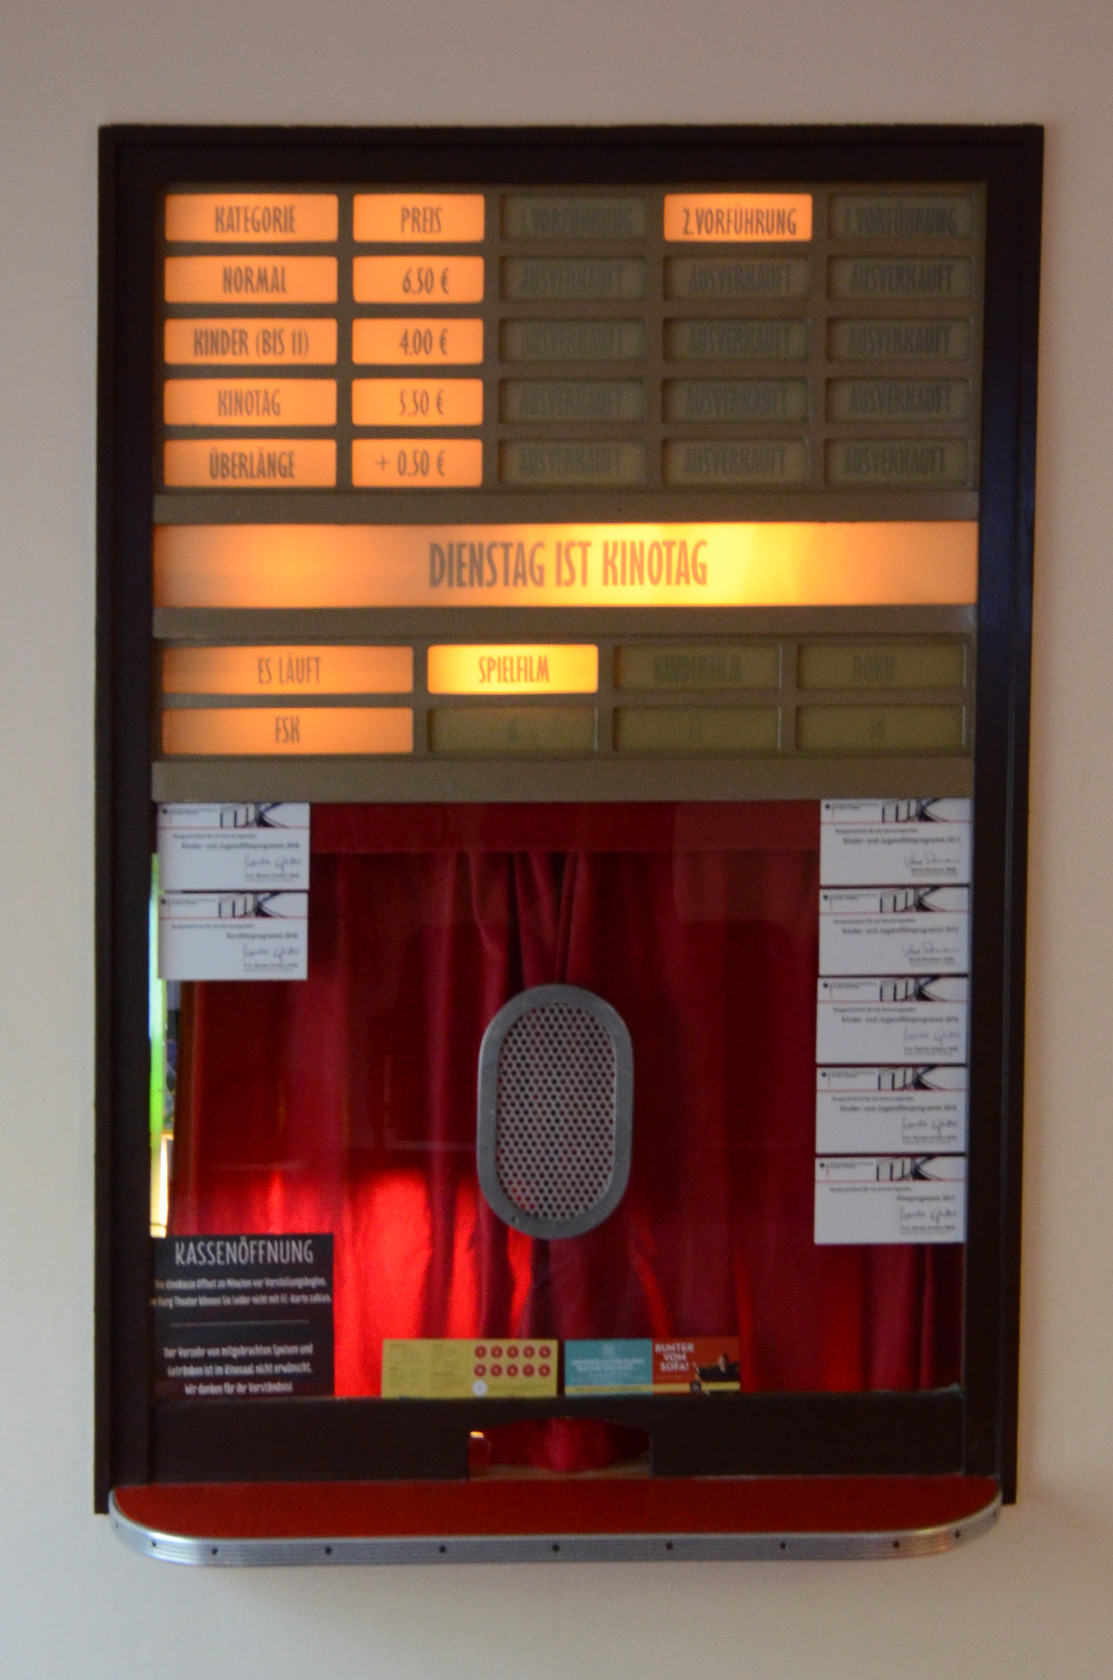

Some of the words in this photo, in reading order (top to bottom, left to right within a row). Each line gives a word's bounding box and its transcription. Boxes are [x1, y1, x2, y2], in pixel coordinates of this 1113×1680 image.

[214, 205, 296, 234] KATEGORIE
[400, 206, 443, 234] PREIS
[222, 266, 287, 294] NORMAL
[402, 266, 434, 295] 6.50
[440, 266, 450, 294] €
[193, 328, 249, 356] KINDER
[255, 328, 286, 358] (BIS
[399, 328, 433, 356] 4.00
[438, 328, 448, 356] €
[217, 389, 281, 416] KINOTAG
[399, 389, 430, 416] 5.50
[435, 389, 444, 416] €
[209, 447, 295, 480] ÜBERLÄNGE
[397, 449, 430, 477] 0.50
[436, 449, 445, 477] €
[429, 541, 544, 589] DIENSTAG
[554, 540, 592, 588] IST
[602, 539, 707, 587] KINOTAG
[257, 653, 275, 686] ES
[278, 652, 321, 685] LÄUFT
[478, 656, 551, 685] SPIELFILM
[274, 715, 301, 745] FSK
[174, 1236, 315, 1266] KASSENÖFFNUNG
